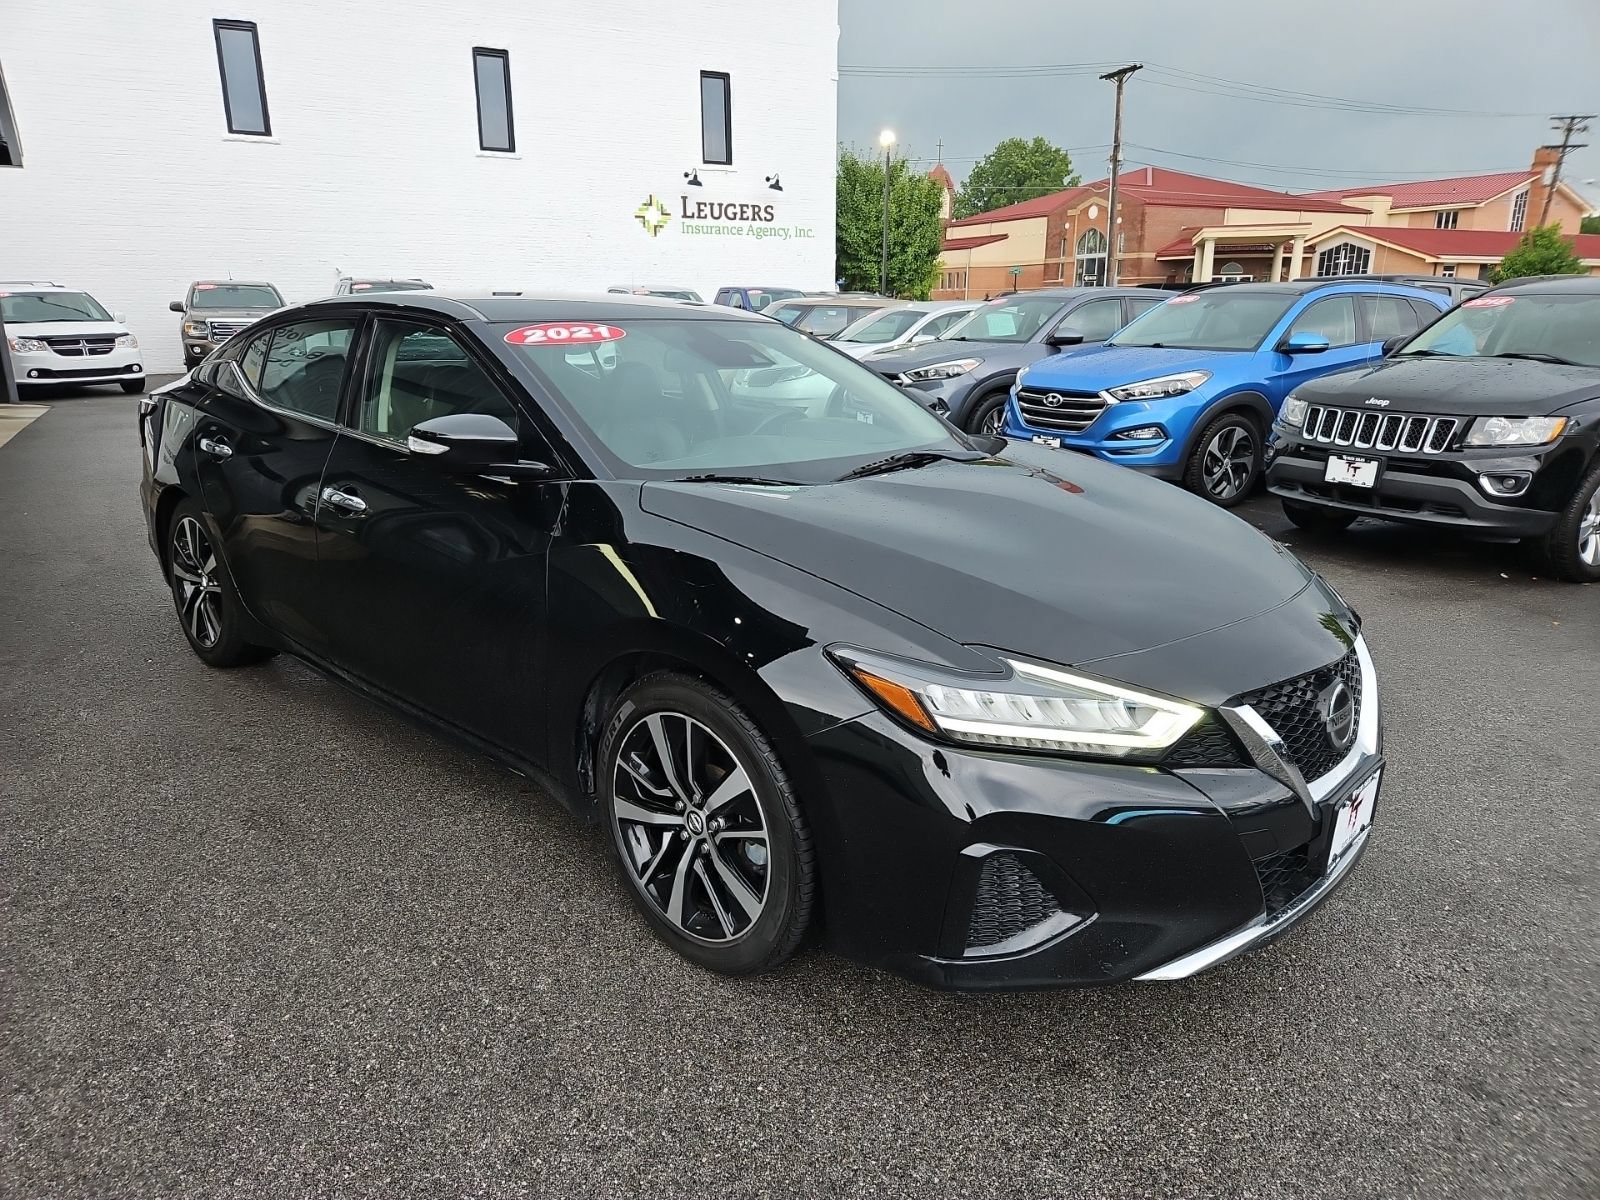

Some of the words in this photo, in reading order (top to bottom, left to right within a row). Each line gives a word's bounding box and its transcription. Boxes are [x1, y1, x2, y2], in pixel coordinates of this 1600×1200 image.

[681, 195, 775, 222] LEUGERS
[681, 222, 743, 236] Insurance
[746, 223, 792, 240] Agency,
[795, 226, 815, 238] Inc.
[522, 326, 612, 343] 2021
[1365, 397, 1390, 407] Jeep
